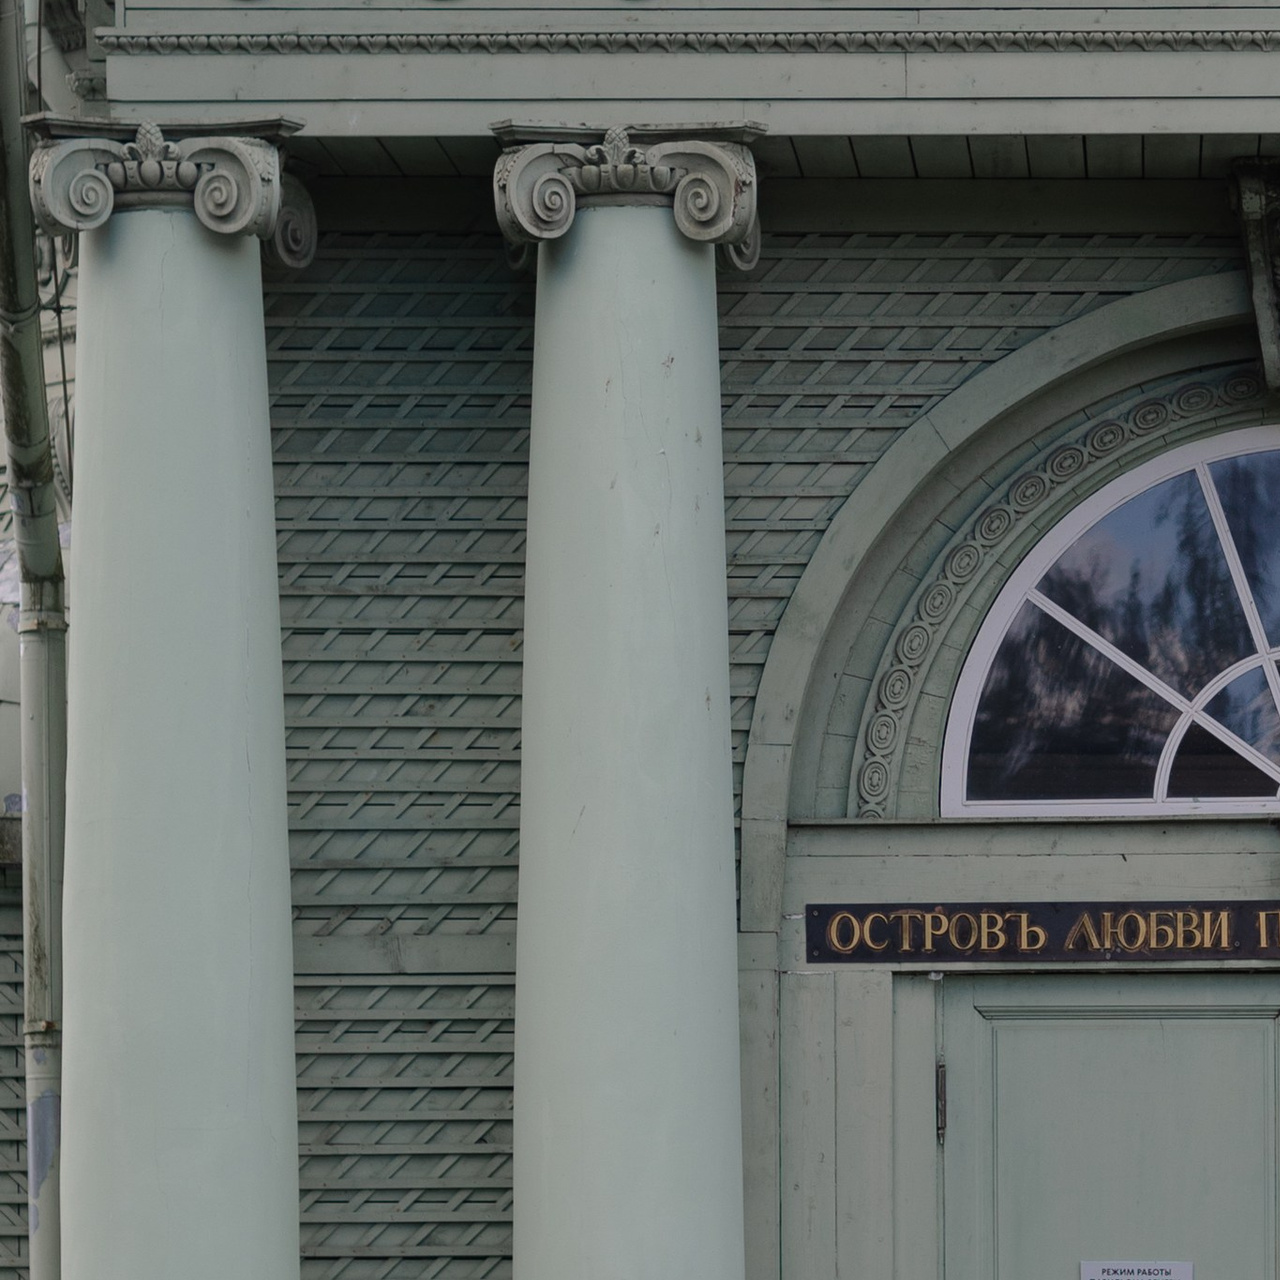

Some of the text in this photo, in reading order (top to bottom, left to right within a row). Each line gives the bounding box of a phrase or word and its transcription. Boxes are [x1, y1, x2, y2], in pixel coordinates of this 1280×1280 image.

[829, 912, 1047, 951] ОСТРОВЪ
[1066, 910, 1232, 950] ЛЮБВИ
[1102, 1268, 1171, 1276] РЕЖИМ РАБОТЫ
